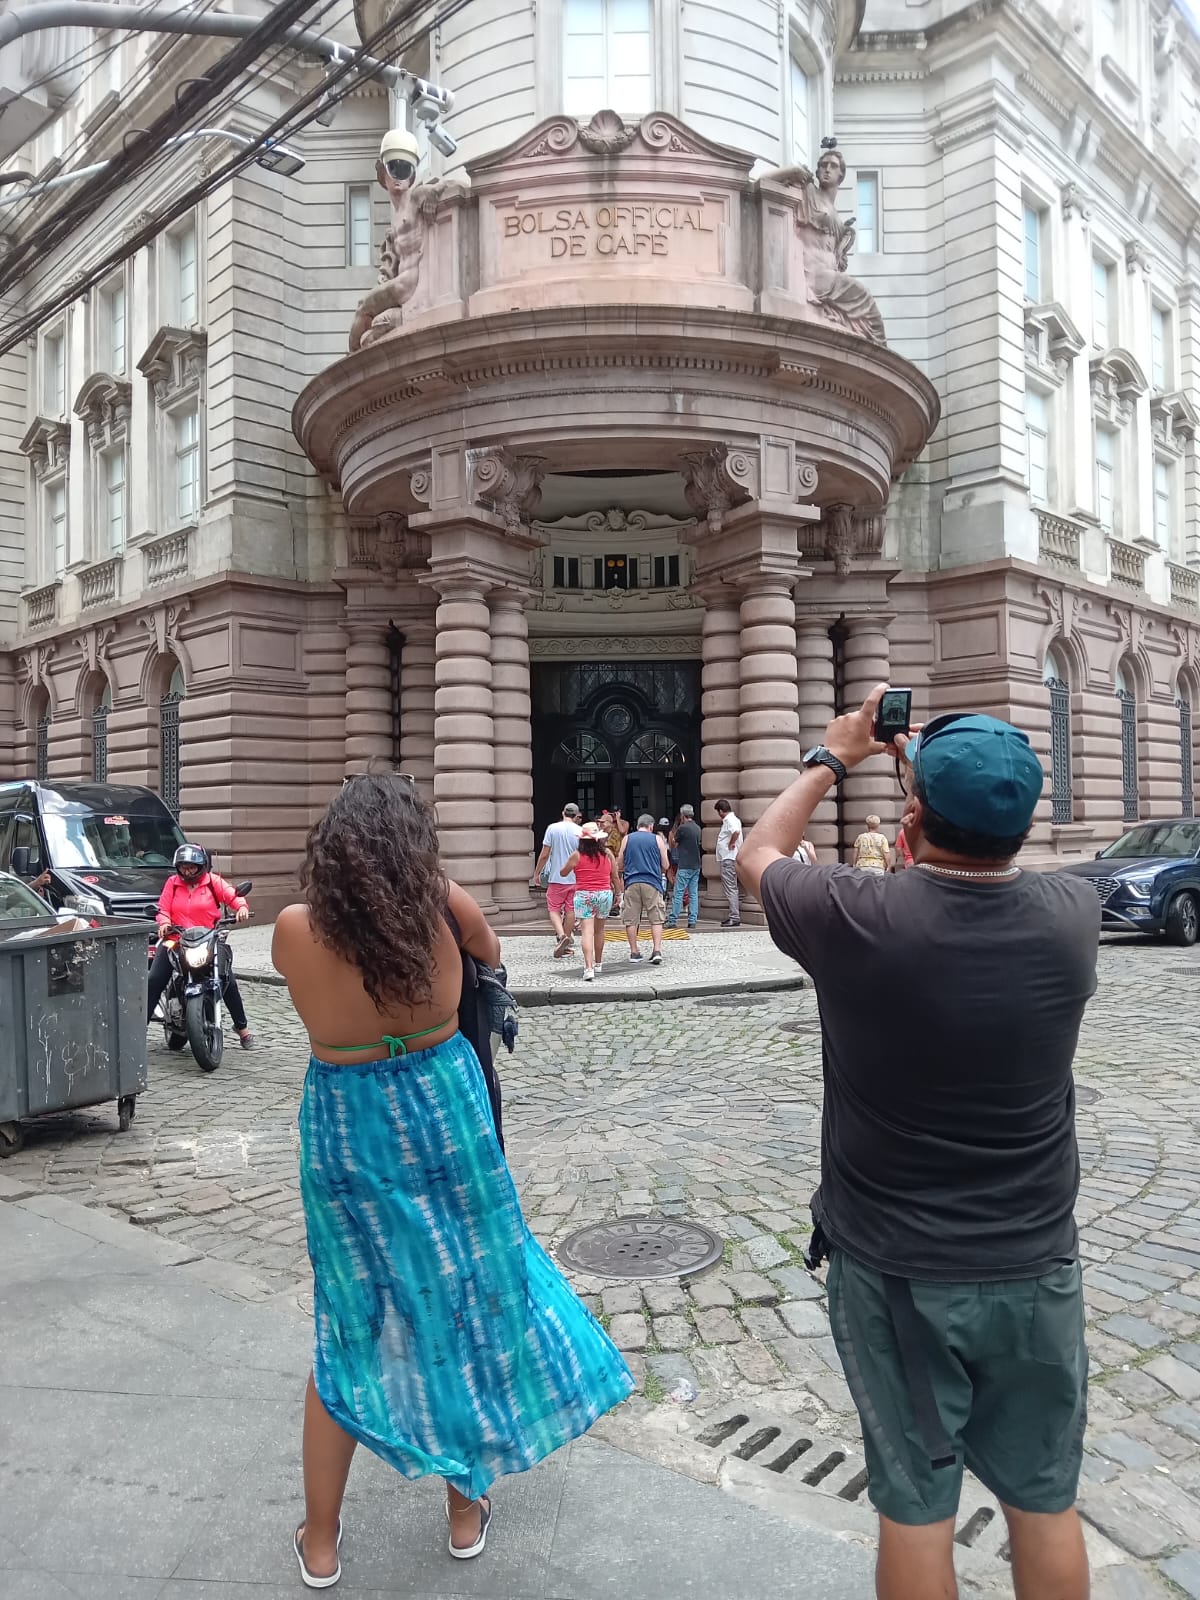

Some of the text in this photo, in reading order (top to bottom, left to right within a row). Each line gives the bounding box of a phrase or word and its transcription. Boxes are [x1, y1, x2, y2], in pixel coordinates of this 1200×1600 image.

[504, 207, 713, 237] BOLSA OFFICIAL
[550, 235, 587, 257] DE
